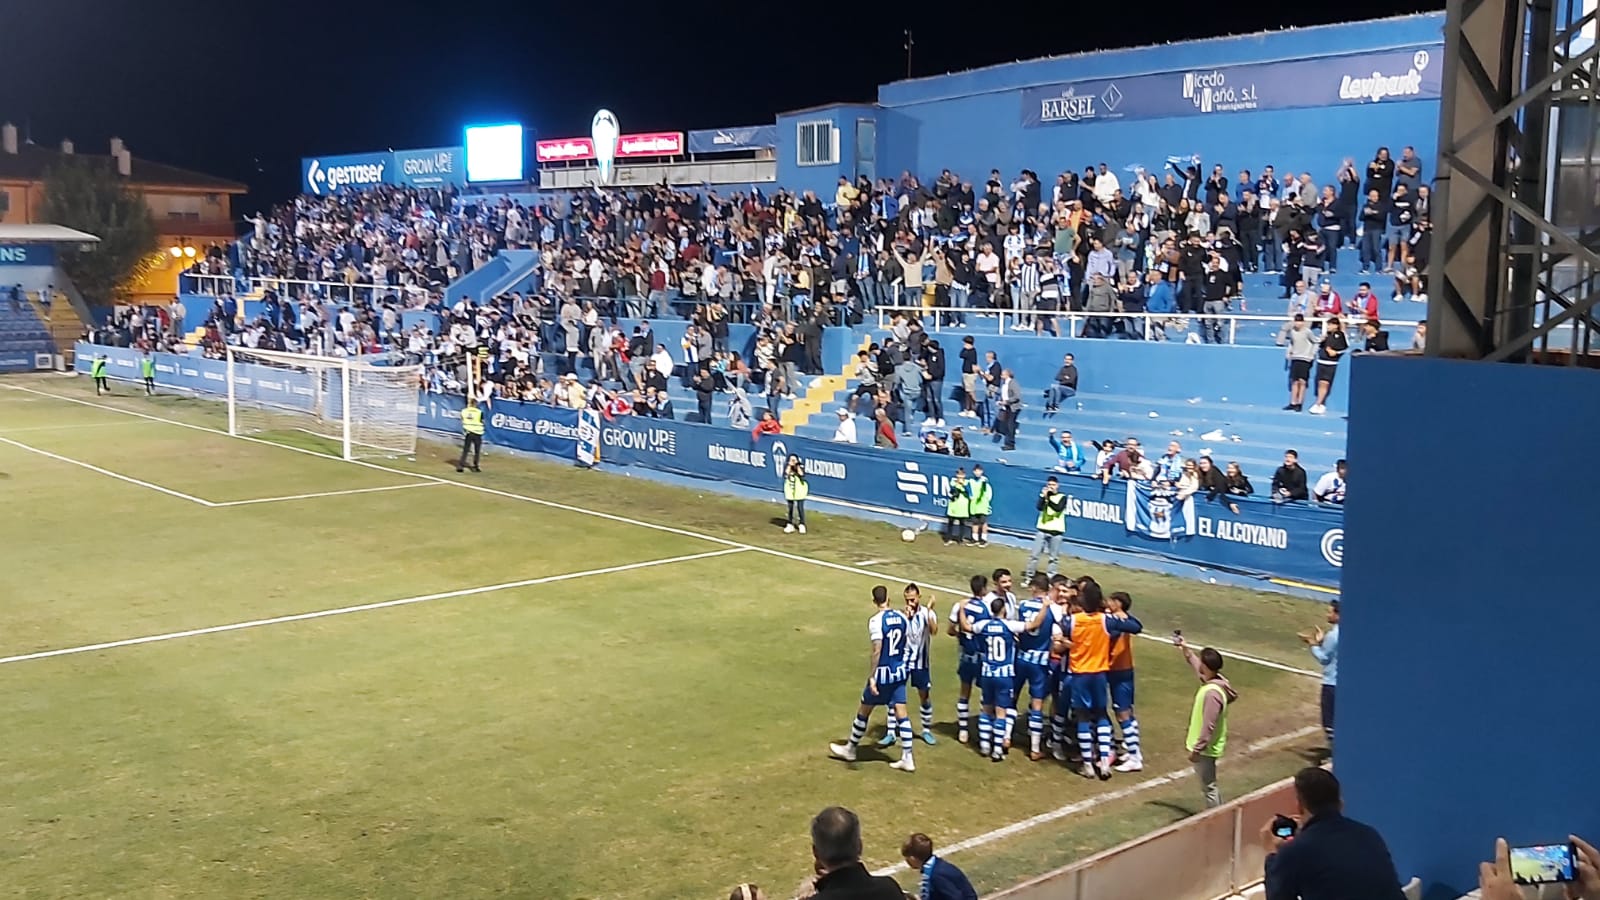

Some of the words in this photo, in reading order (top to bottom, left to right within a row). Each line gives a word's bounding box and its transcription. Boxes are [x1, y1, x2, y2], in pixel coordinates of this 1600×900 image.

[1339, 69, 1422, 103] Levipark
[1041, 98, 1096, 121] BARSEL
[403, 159, 434, 175] GROW
[603, 427, 648, 450] GROW
[649, 429, 669, 447] UP
[1064, 494, 1081, 518] ÁS
[1082, 500, 1124, 524] MORAL
[1199, 517, 1215, 537] EL
[1216, 520, 1288, 549] ALCOYANO
[886, 628, 902, 656] 12
[984, 634, 1006, 662] 10
